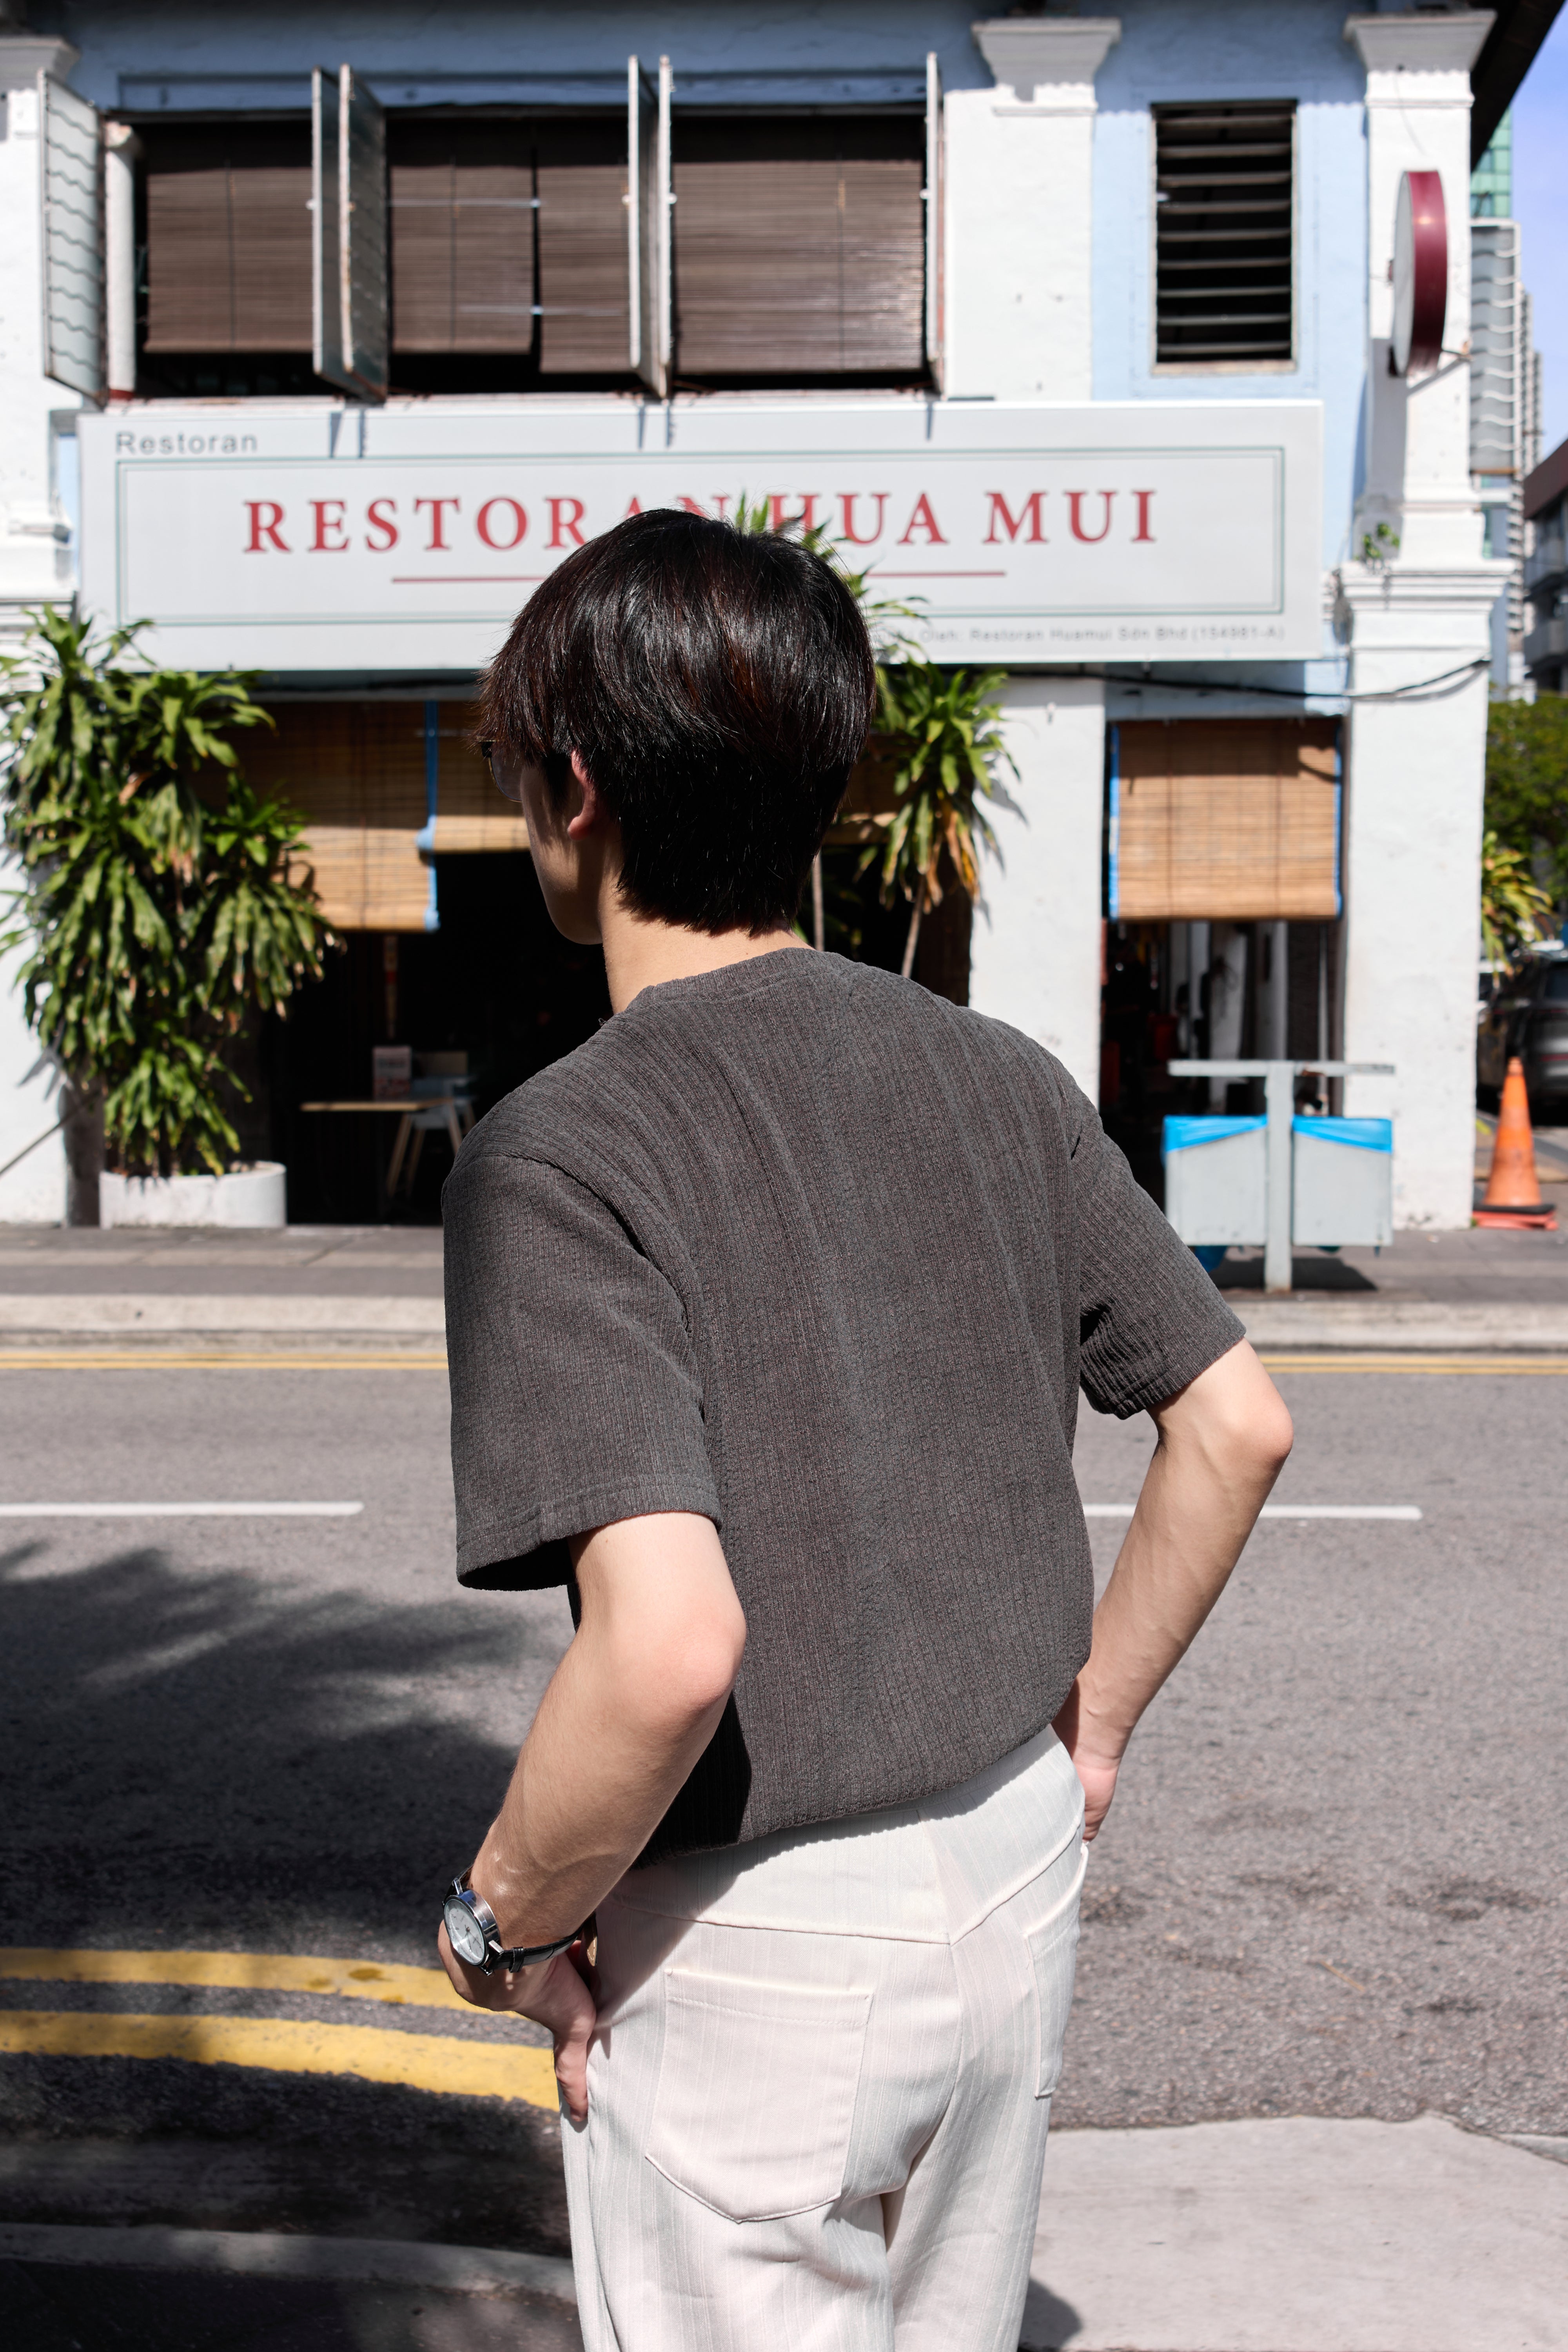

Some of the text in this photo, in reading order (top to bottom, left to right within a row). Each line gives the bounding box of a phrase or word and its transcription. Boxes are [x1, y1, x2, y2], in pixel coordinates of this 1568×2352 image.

[115, 430, 258, 455] Restoran
[767, 492, 949, 545] HUA
[982, 490, 1156, 543] MUI
[969, 627, 1044, 642] Restoran
[1049, 627, 1112, 641] Huamui
[1118, 626, 1149, 641] Sdn
[1156, 626, 1187, 641] Bhd
